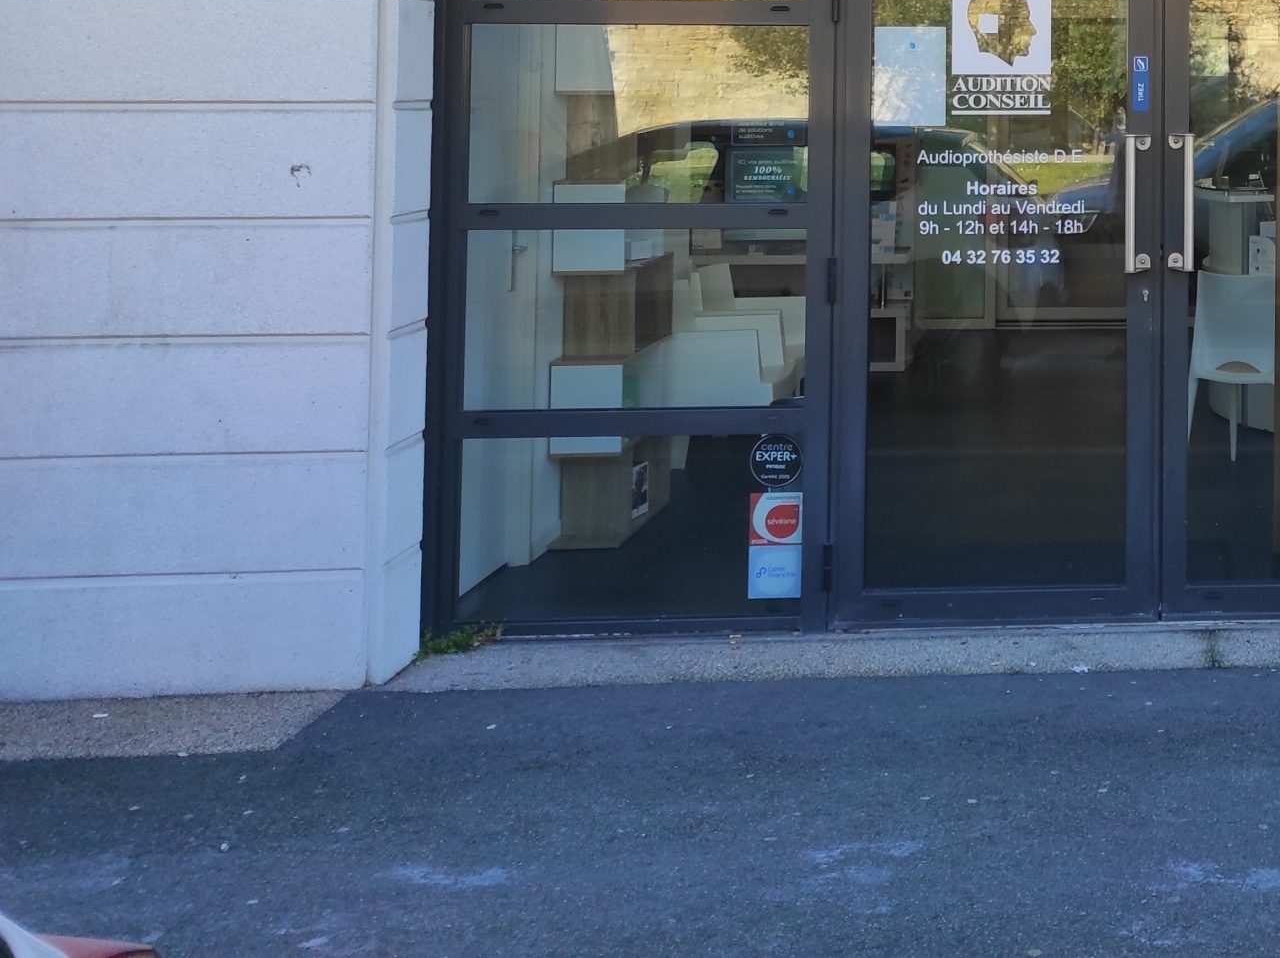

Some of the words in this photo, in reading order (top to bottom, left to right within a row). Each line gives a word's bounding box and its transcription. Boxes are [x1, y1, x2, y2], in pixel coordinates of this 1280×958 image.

[952, 76, 1050, 92] AUDITION
[952, 93, 1050, 109] CONSEIL
[917, 149, 1049, 167] Audioprothésiste
[1053, 149, 1087, 165] D.E.
[754, 166, 782, 174] 100%
[966, 181, 1038, 196] Horaires
[918, 200, 938, 216] du
[943, 200, 986, 216] Lundi
[991, 204, 1011, 216] au
[1016, 200, 1085, 216] Vendredi
[919, 220, 940, 235] 9h
[956, 220, 984, 235] 12h
[989, 220, 1005, 235] et
[1010, 220, 1038, 235] 14h
[1055, 219, 1083, 235] 18h
[942, 250, 961, 265] 04
[966, 250, 986, 265] 32
[991, 250, 1011, 265] 76
[1016, 250, 1036, 265] 35
[1040, 250, 1060, 264] 32
[761, 443, 793, 451] centre
[756, 451, 797, 461] EXPER+
